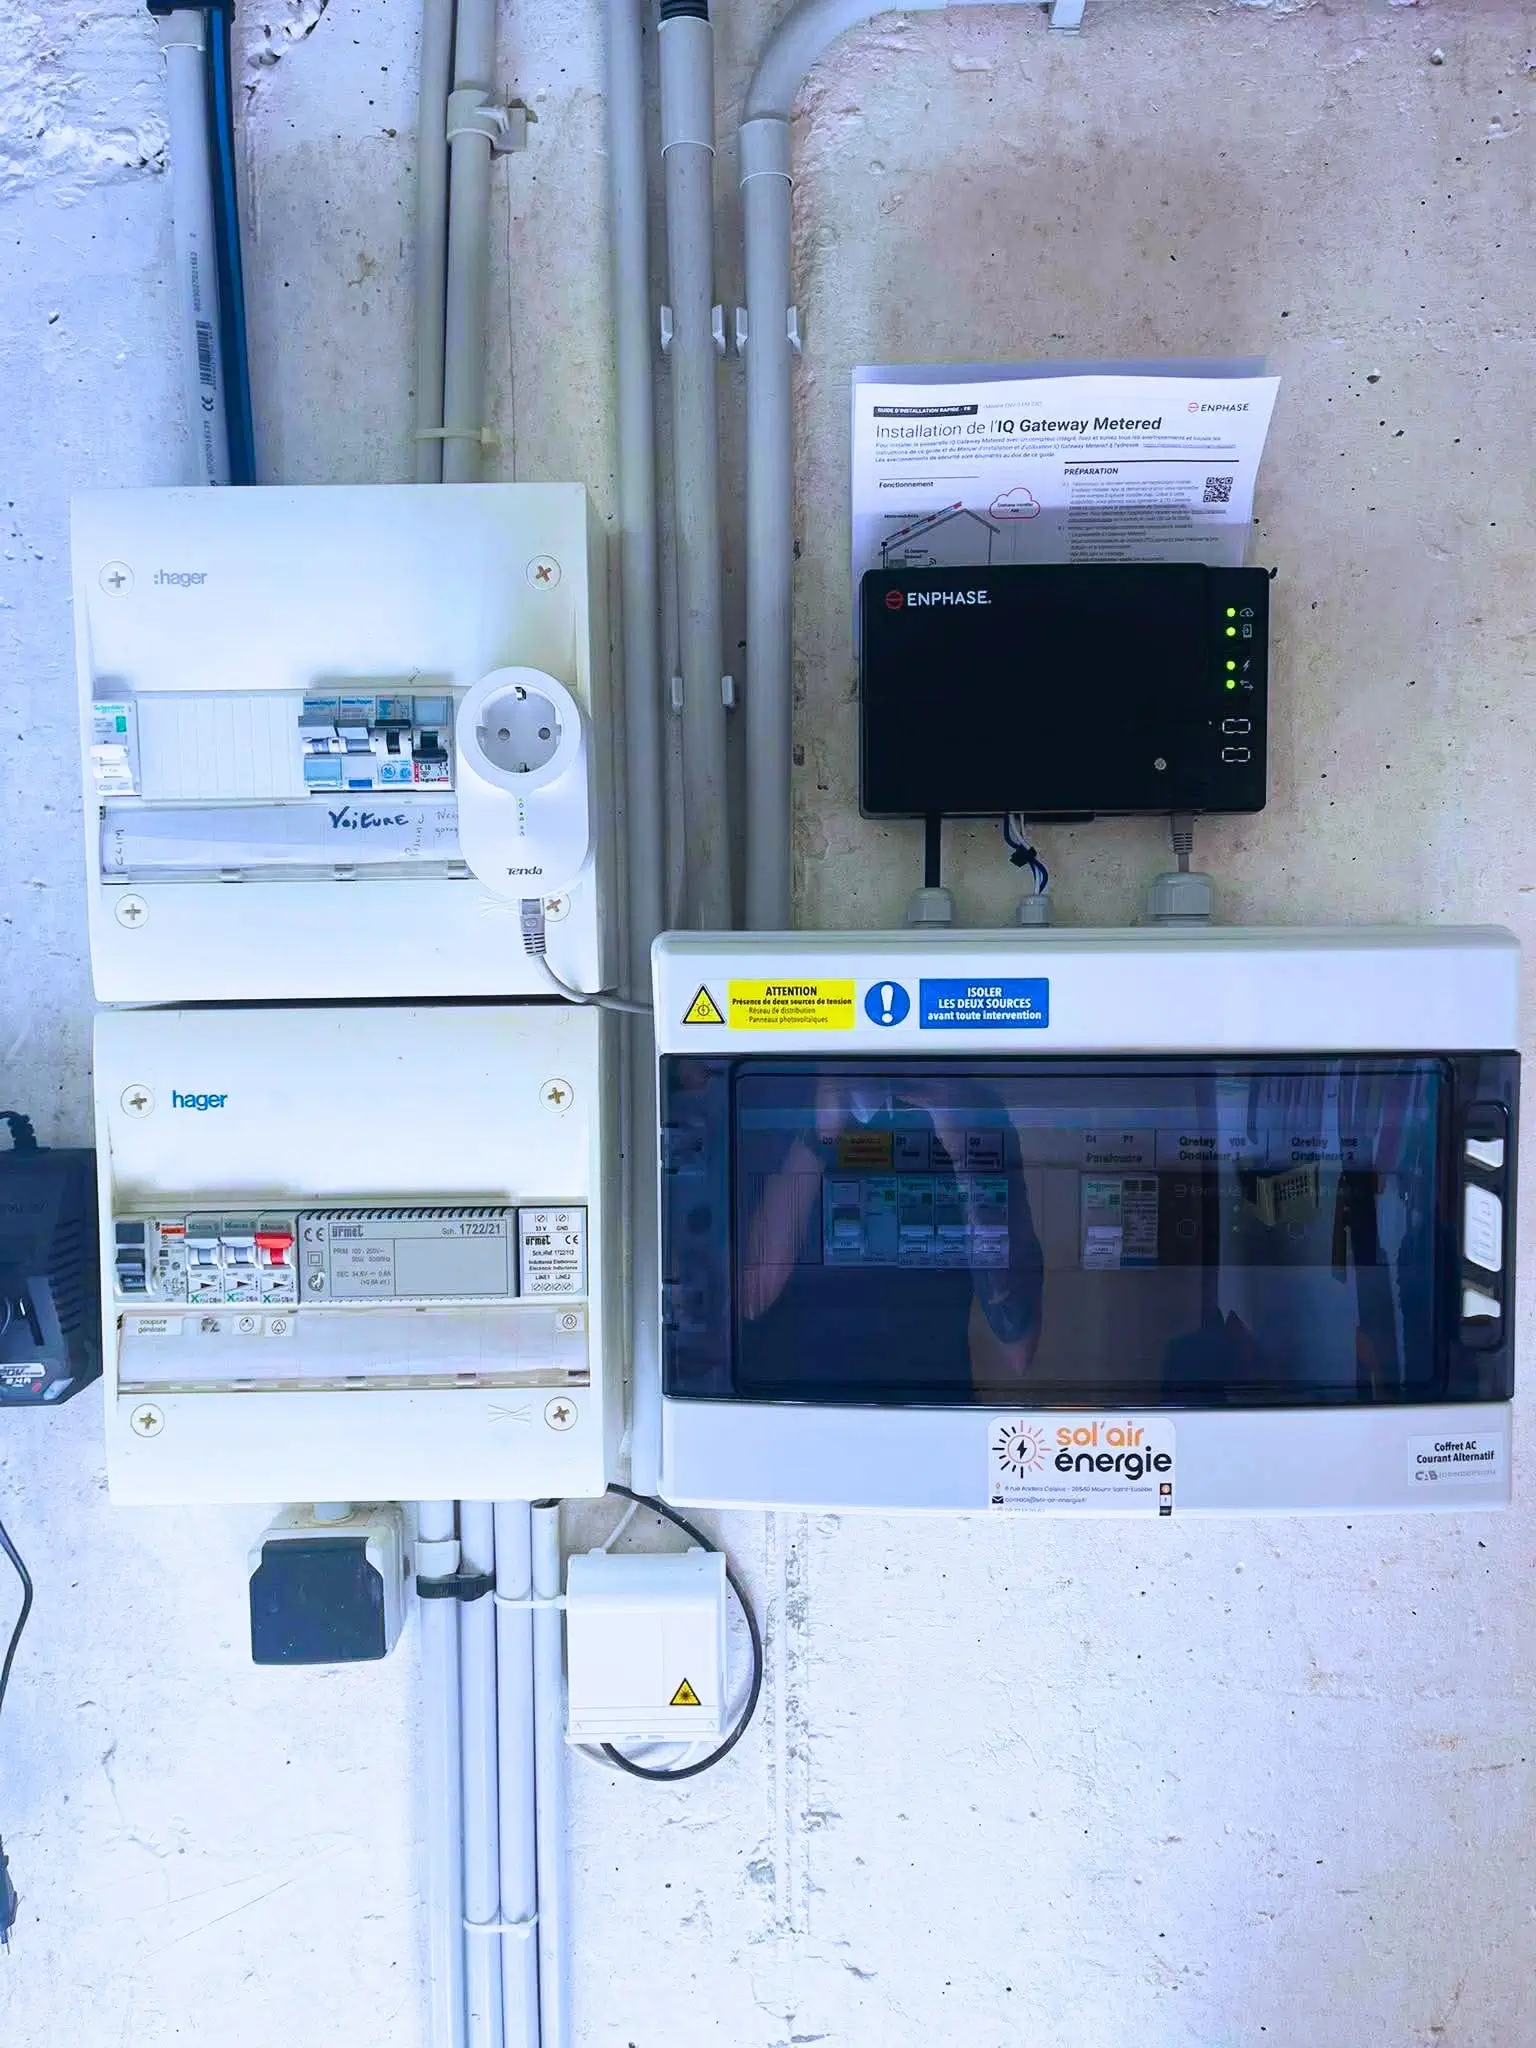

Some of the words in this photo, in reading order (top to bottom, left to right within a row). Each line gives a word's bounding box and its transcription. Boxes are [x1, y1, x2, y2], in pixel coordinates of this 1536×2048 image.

[1200, 403, 1249, 412] ENPHASE
[876, 424, 962, 439] Installation
[966, 422, 985, 435] de
[990, 419, 1015, 433] l'IQ
[1020, 419, 1089, 434] Gateway
[1094, 417, 1162, 430] Metered
[1064, 467, 1119, 476] PRÉPARATION
[879, 481, 934, 489] Fonctionnement
[506, 866, 543, 875] Tenda
[765, 986, 817, 996] ATTENTION
[967, 987, 1002, 998] ISOLER
[938, 999, 956, 1009] LES
[957, 999, 985, 1009] DEUX
[986, 998, 1032, 1009] SOURCES
[928, 1012, 955, 1020] avant
[955, 1011, 982, 1020] toute
[983, 1010, 1042, 1020] intervention
[172, 1090, 228, 1111] hager
[332, 1225, 364, 1238] urmet
[441, 1227, 457, 1236] Sch.
[459, 1223, 502, 1235] 1722/21
[525, 1235, 552, 1246] urmet
[565, 1235, 579, 1245] CE
[1056, 1420, 1145, 1447] sol'air
[1434, 1441, 1464, 1452] Coffret
[1465, 1441, 1477, 1450] AC
[1416, 1454, 1452, 1464] Courant
[1453, 1450, 1495, 1462] Alternatif
[1054, 1445, 1172, 1481] énergie
